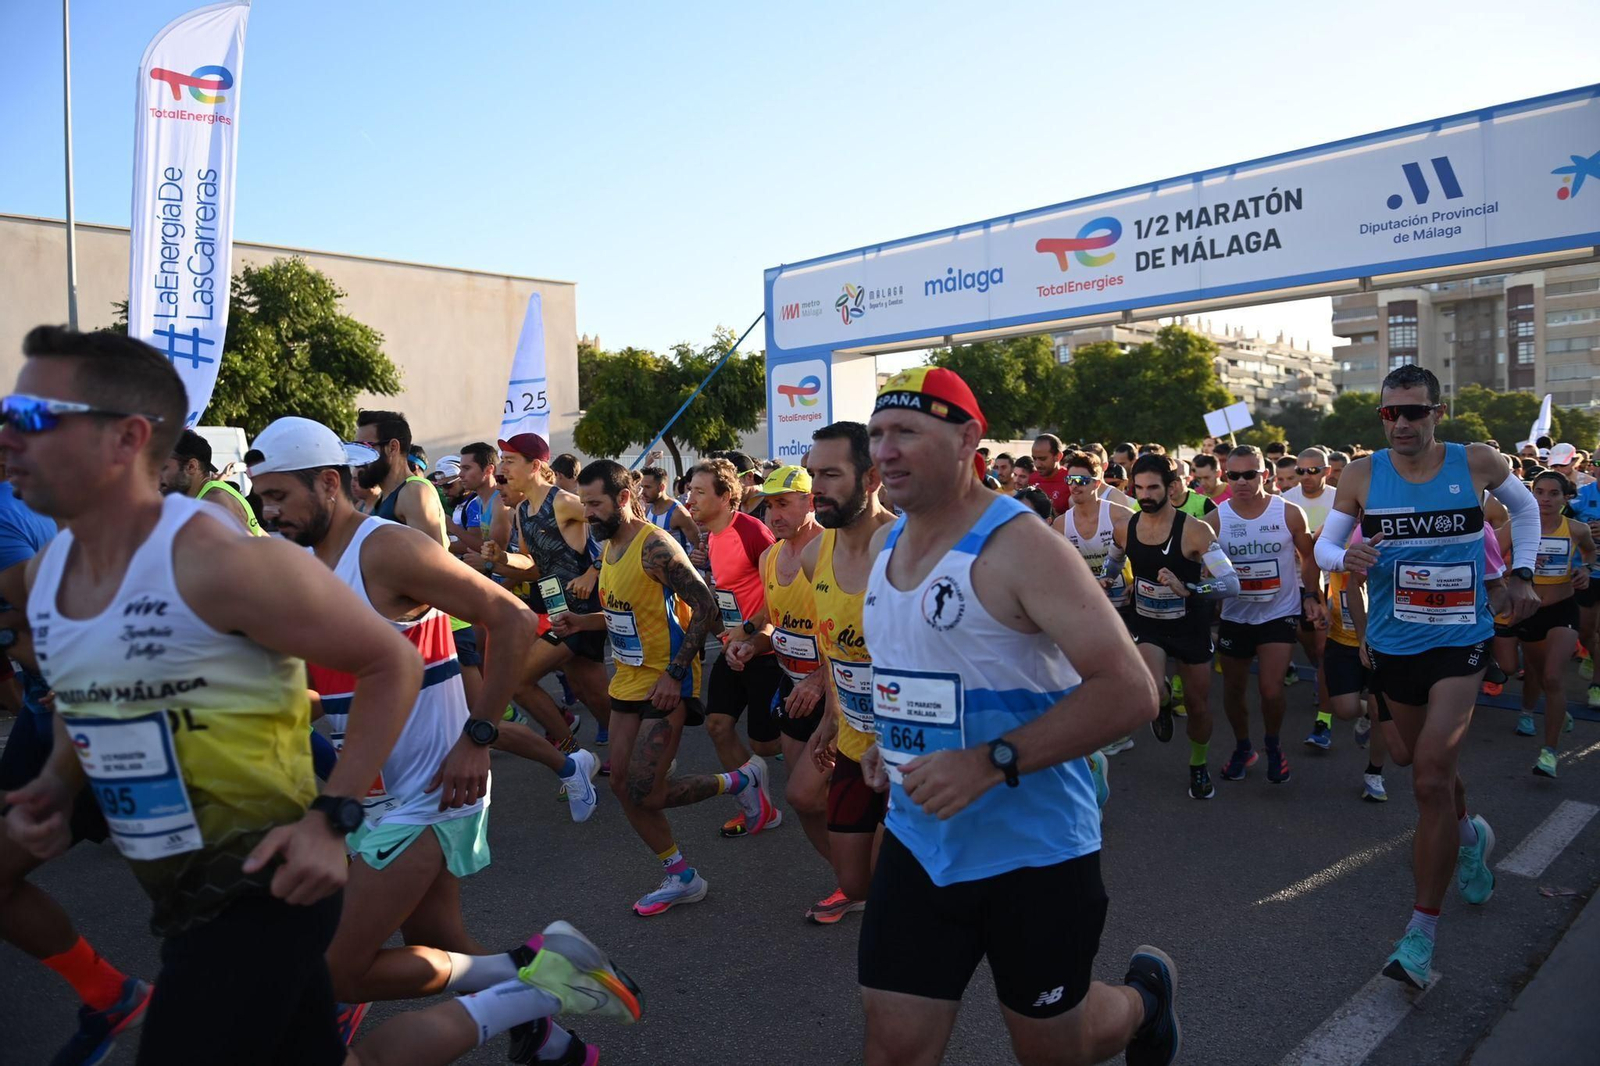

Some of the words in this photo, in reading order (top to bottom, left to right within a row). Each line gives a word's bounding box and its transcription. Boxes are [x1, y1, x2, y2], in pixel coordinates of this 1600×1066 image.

[150, 107, 232, 126] TotalEnergies
[1134, 215, 1170, 240] 1/2
[1175, 187, 1303, 232] MARATÓN
[1360, 214, 1428, 235] Diputación
[1431, 201, 1499, 223] Provincial
[186, 168, 218, 320] LasCarreras
[1393, 232, 1410, 244] de
[1413, 225, 1462, 241] Málaga
[1135, 247, 1165, 272] DE
[1171, 228, 1282, 266] MÁLAGA
[924, 266, 1004, 297] málaga
[1036, 275, 1124, 298] TotalEnergies
[801, 300, 821, 309] metro
[521, 390, 547, 412] 25
[876, 391, 921, 409] SPAÑA
[778, 411, 822, 423] TotalEnergies
[778, 439, 813, 456] mála
[1228, 540, 1282, 556] bathco
[1425, 593, 1446, 606] 49
[782, 610, 814, 630] Álora
[837, 624, 865, 648] Álo
[115, 678, 208, 702] MÁLAGA
[891, 726, 926, 752] 664
